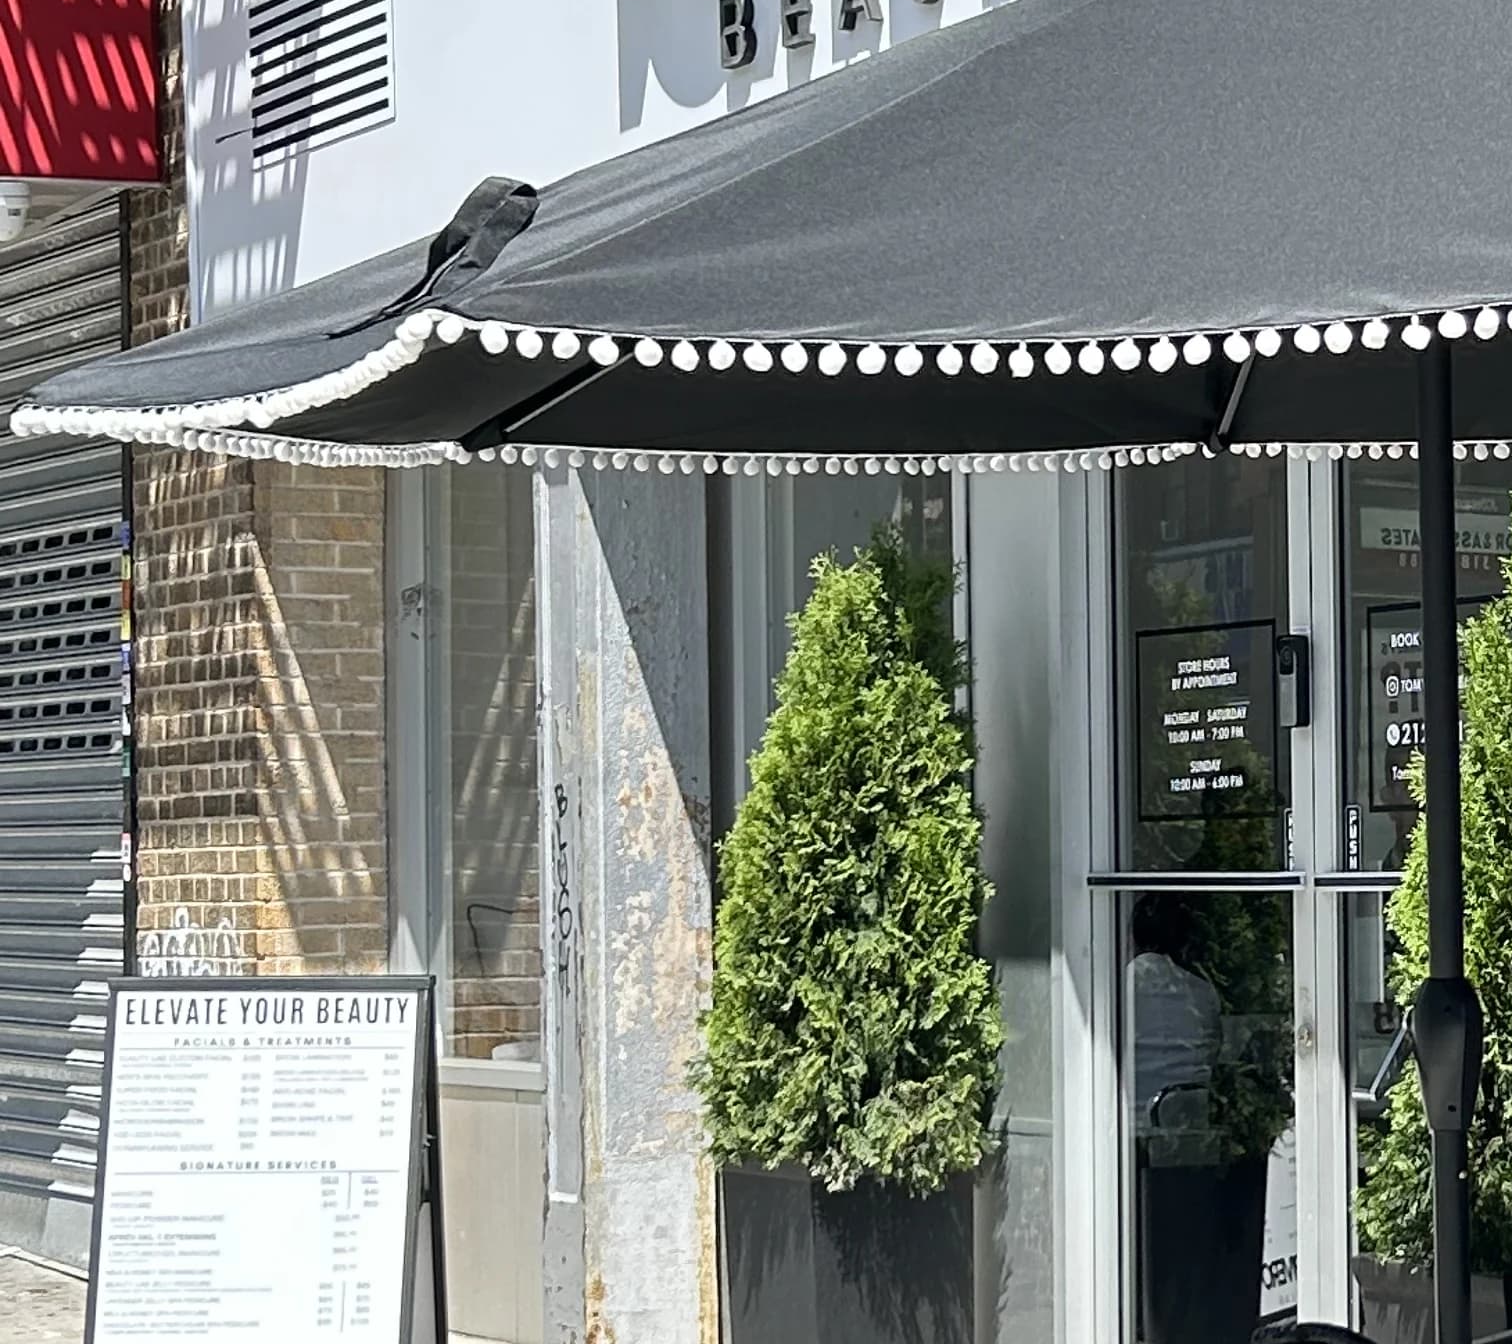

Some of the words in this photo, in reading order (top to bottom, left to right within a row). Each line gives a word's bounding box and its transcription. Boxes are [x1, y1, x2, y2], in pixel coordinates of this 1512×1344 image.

[1391, 632, 1420, 648] BOOK
[1207, 706, 1248, 723] SATURDAY
[1191, 728, 1205, 742] AM
[1211, 727, 1230, 741] 7:00
[1190, 758, 1222, 773] SUNDAY
[1192, 776, 1206, 790] AM
[1349, 809, 1358, 871] PUSH
[125, 998, 229, 1025] ELEVATE
[240, 997, 305, 1025] YOUR
[317, 997, 410, 1024] BEAUTY
[174, 1038, 236, 1047] FACIALS
[259, 1037, 352, 1046] TREATMENTS
[180, 1161, 261, 1171] SIGNATURE
[268, 1160, 337, 1170] SERVICES
